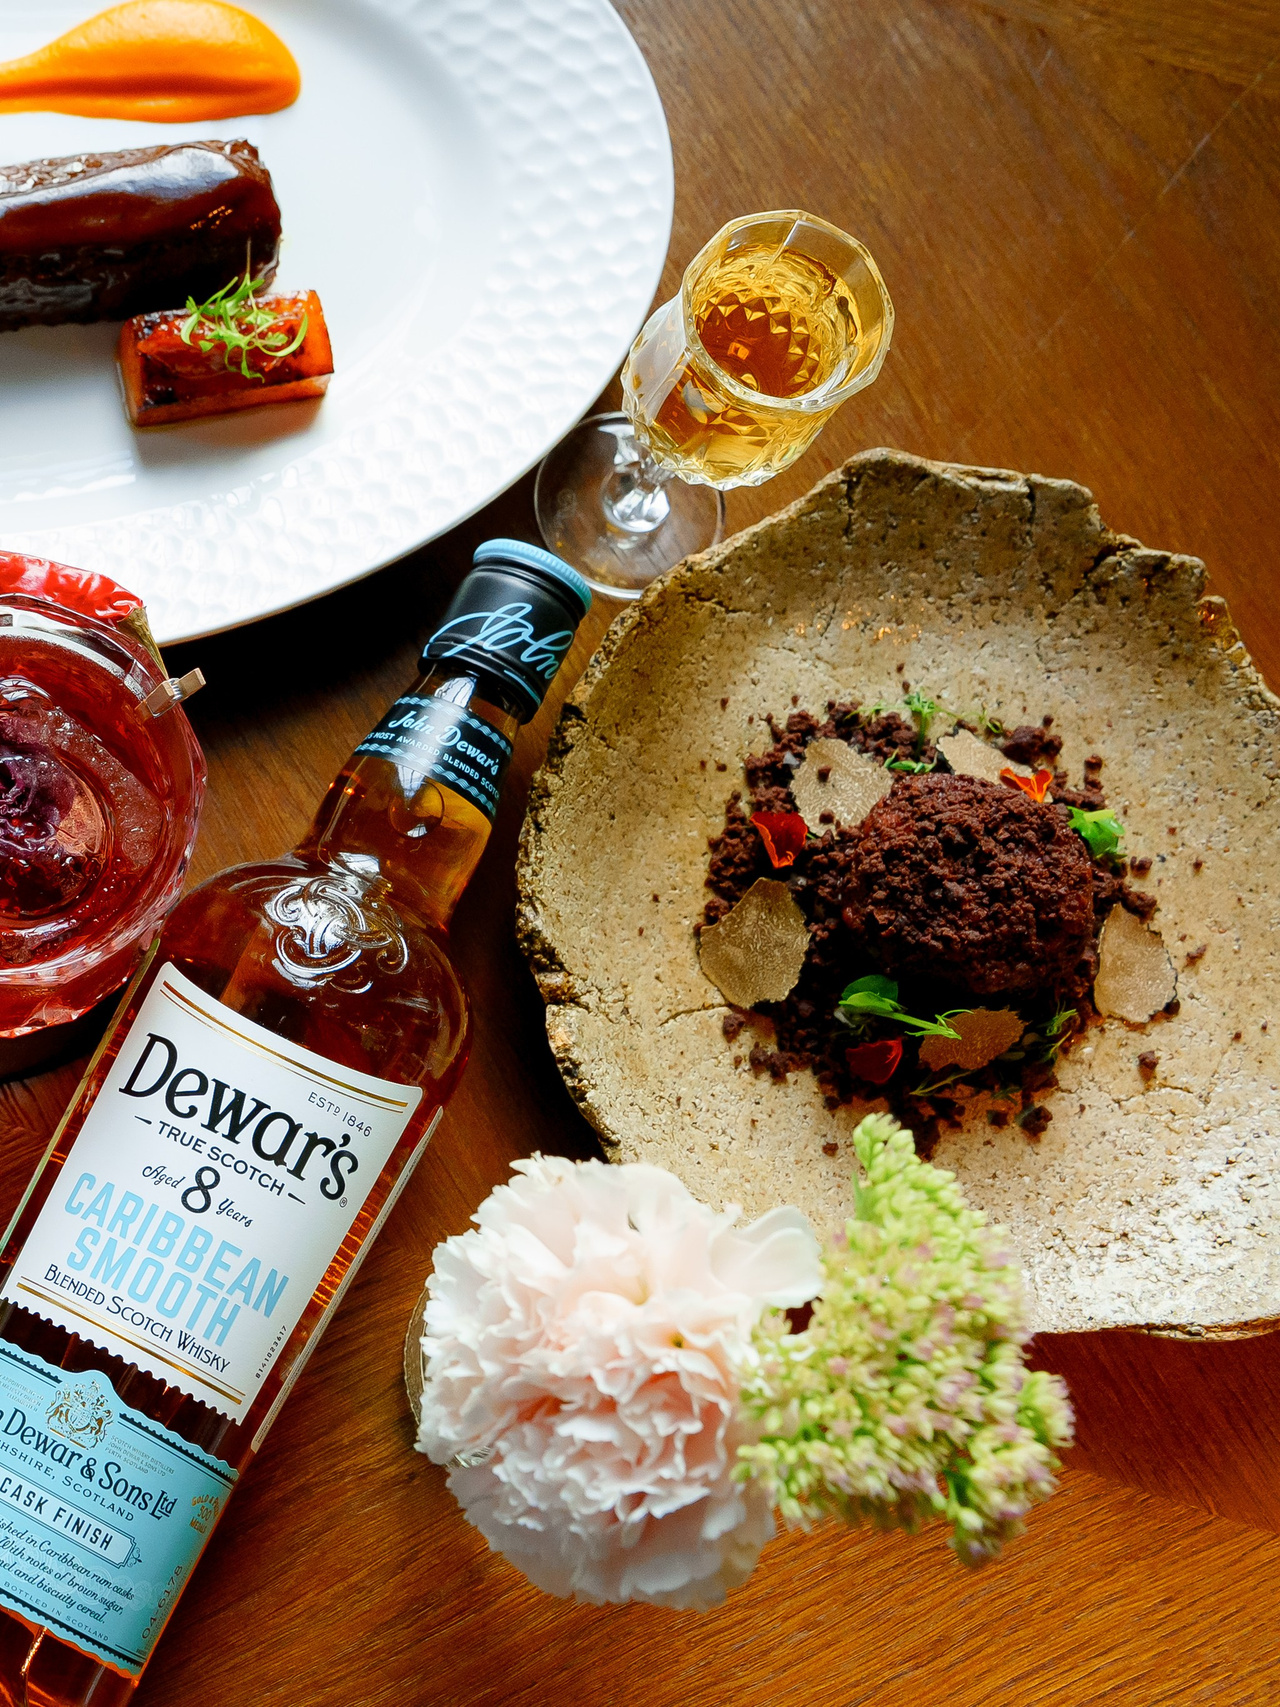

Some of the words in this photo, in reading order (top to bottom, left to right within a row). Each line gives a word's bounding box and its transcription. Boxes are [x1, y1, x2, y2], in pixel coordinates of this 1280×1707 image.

[374, 732, 395, 741] MOST
[396, 735, 440, 756] AWARDED
[443, 752, 480, 780] BLENDED
[388, 710, 435, 735] John
[435, 725, 500, 776] Dewar's
[118, 1032, 358, 1206] Dewar's
[308, 1092, 340, 1116] ESTD
[342, 1112, 372, 1137] 1846
[159, 1120, 207, 1154] TRUE
[207, 1146, 285, 1196] SCOTCH
[142, 1166, 186, 1188] Aged
[181, 1166, 220, 1213] 8
[216, 1198, 253, 1227] Years
[65, 1173, 290, 1319] CARIBBEAN
[44, 1264, 105, 1305] BLENDED
[106, 1296, 173, 1342] SCOTCH
[177, 1330, 230, 1373] WHISKY
[67, 1227, 241, 1347] SMOOTH
[2, 1407, 83, 1469] Dewar
[80, 1457, 97, 1482] &
[98, 1462, 153, 1511] Sons
[149, 1490, 178, 1520] Ltd
[0, 1477, 48, 1515] CASK
[53, 1507, 113, 1551] FINISH
[62, 1476, 134, 1521] SCOTLAND
[14, 1569, 40, 1585] and
[37, 1578, 77, 1609] biscuity
[76, 1604, 107, 1624] cereal.
[25, 1535, 37, 1547] in
[39, 1540, 91, 1577] Caribbean
[91, 1573, 112, 1589] rum
[112, 1585, 134, 1600] casks
[25, 1556, 54, 1575] notes
[54, 1572, 71, 1581] of
[67, 1577, 98, 1600] brown
[98, 1597, 123, 1615] sugar,
[4, 1581, 47, 1608] BOTTLED
[51, 1608, 62, 1616] IN
[67, 1616, 109, 1641] SCOTLAND
[142, 1565, 183, 1641] 04-6178
